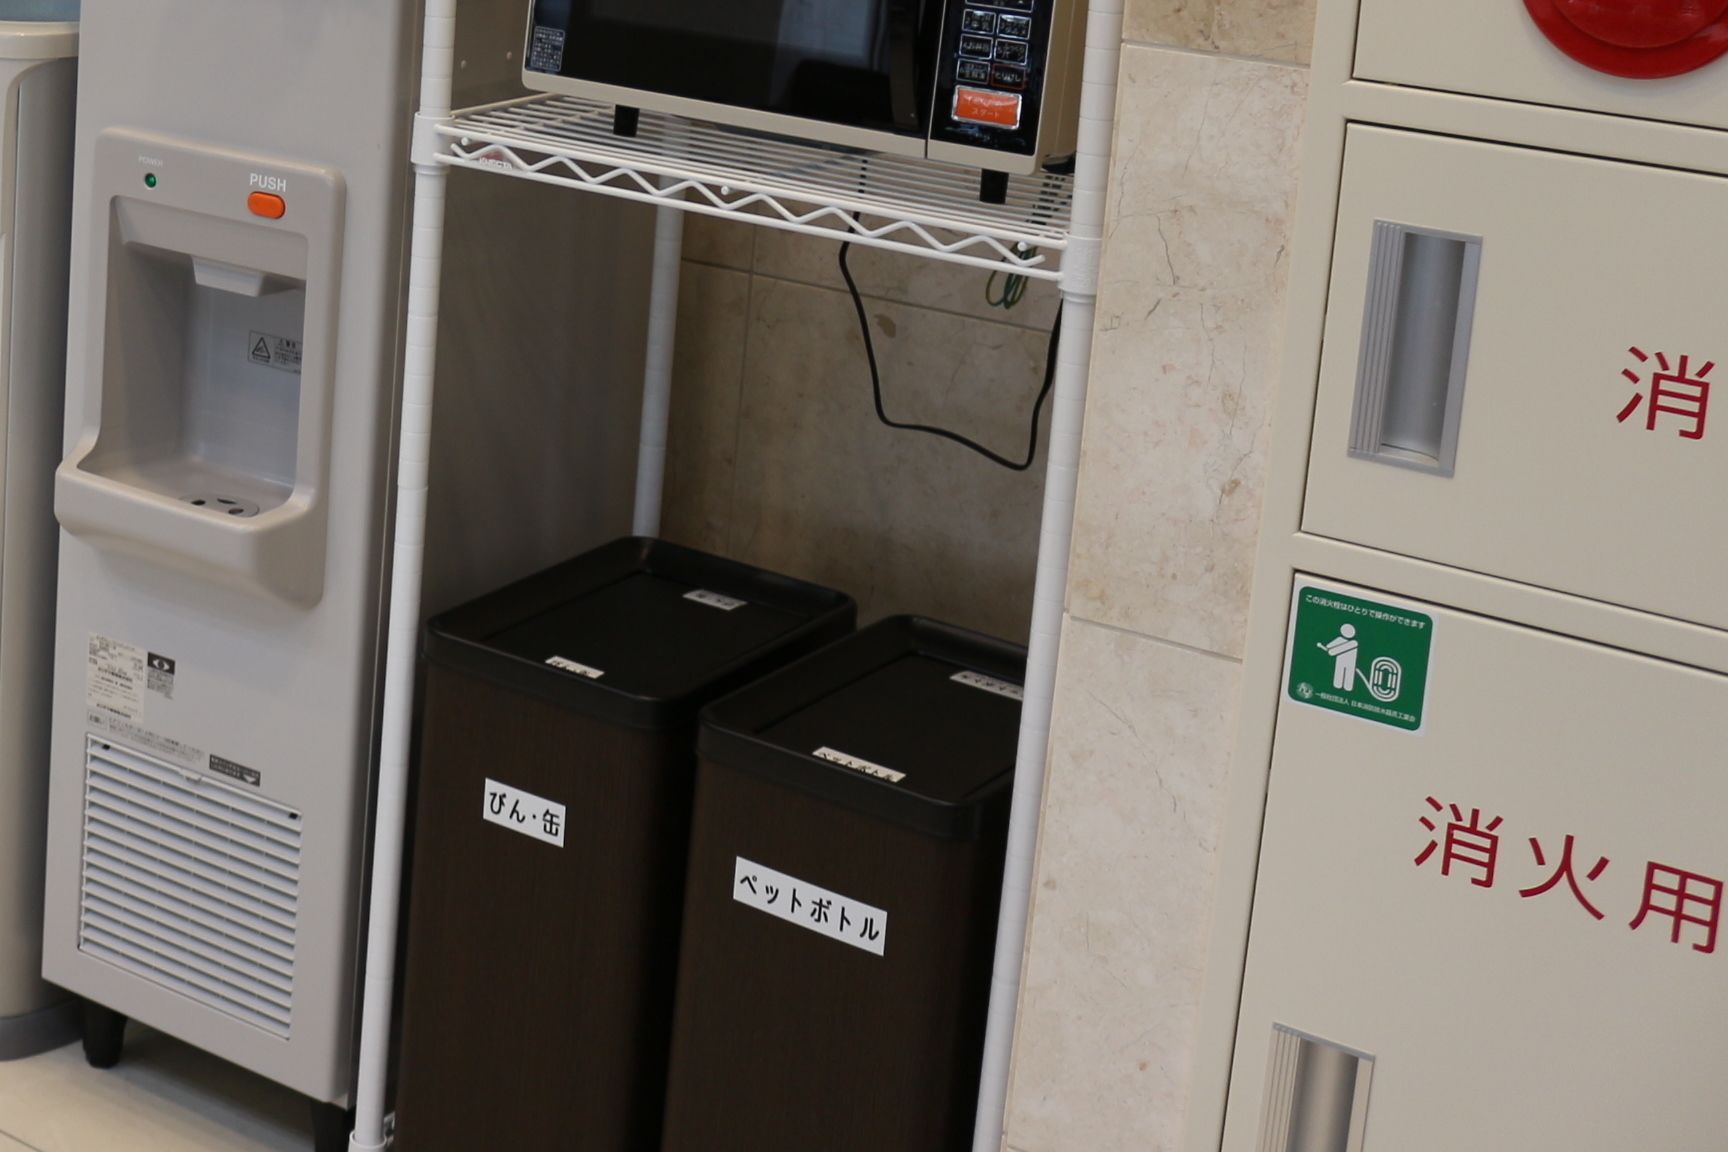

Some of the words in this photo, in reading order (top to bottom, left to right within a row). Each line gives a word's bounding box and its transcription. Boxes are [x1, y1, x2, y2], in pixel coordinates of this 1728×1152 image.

[249, 173, 287, 192] PUSH
[1616, 346, 1716, 440] 消
[1305, 594, 1426, 629] この消火栓はひとりで操作ができます
[488, 790, 561, 837] びん・缶
[1413, 795, 1725, 954] 消火用
[739, 873, 881, 942] ペットボトル
